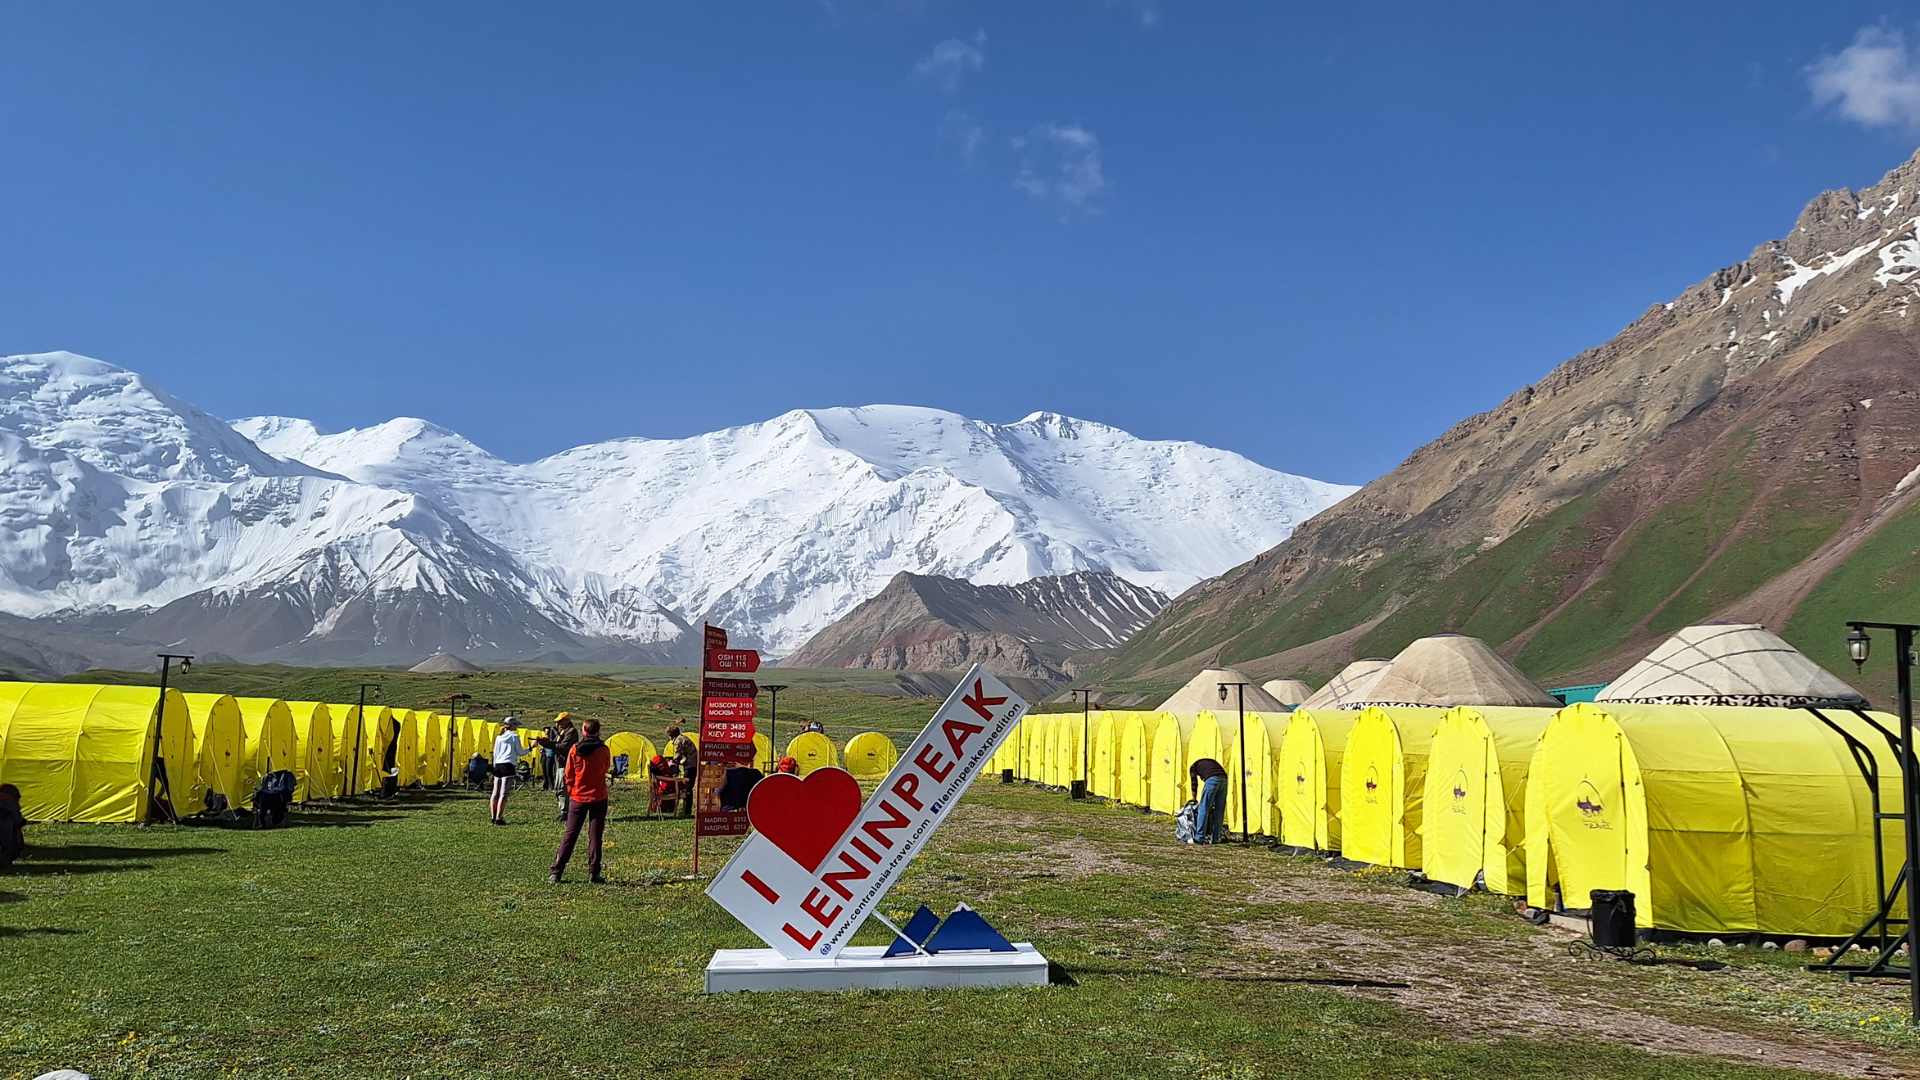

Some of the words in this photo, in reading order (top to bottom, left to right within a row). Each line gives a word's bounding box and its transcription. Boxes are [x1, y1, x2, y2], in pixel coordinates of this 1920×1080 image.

[740, 869, 781, 905] I
[782, 679, 1009, 951] LENINPEAK
[830, 818, 931, 944] www.centralasia-travel.com
[939, 703, 1021, 806] leninpeakexpedition
